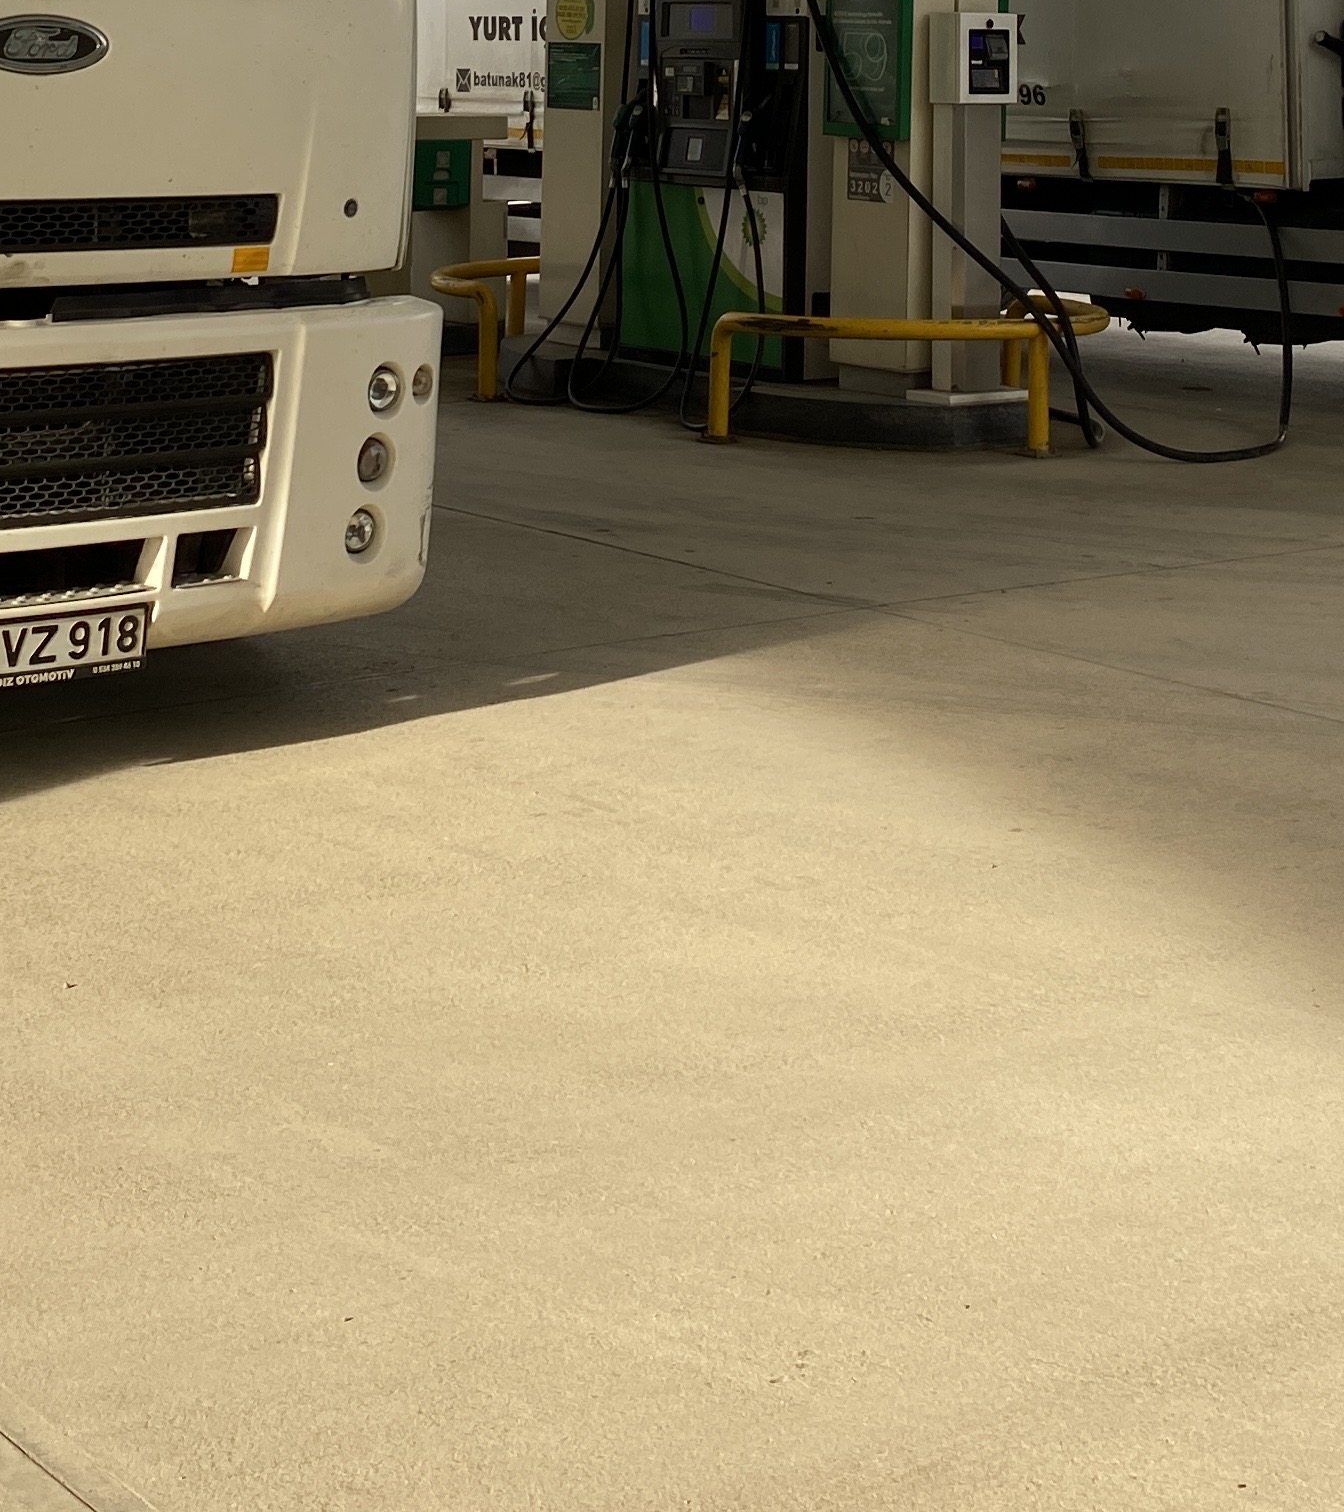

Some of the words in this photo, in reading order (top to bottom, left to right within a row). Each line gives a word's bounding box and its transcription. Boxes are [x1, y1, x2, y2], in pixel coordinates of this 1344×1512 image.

[469, 16, 523, 41] YURT
[850, 180, 879, 194] 3202
[2, 624, 59, 667] VZ
[68, 614, 140, 661] 918
[16, 668, 75, 687] OTOMOTİV
